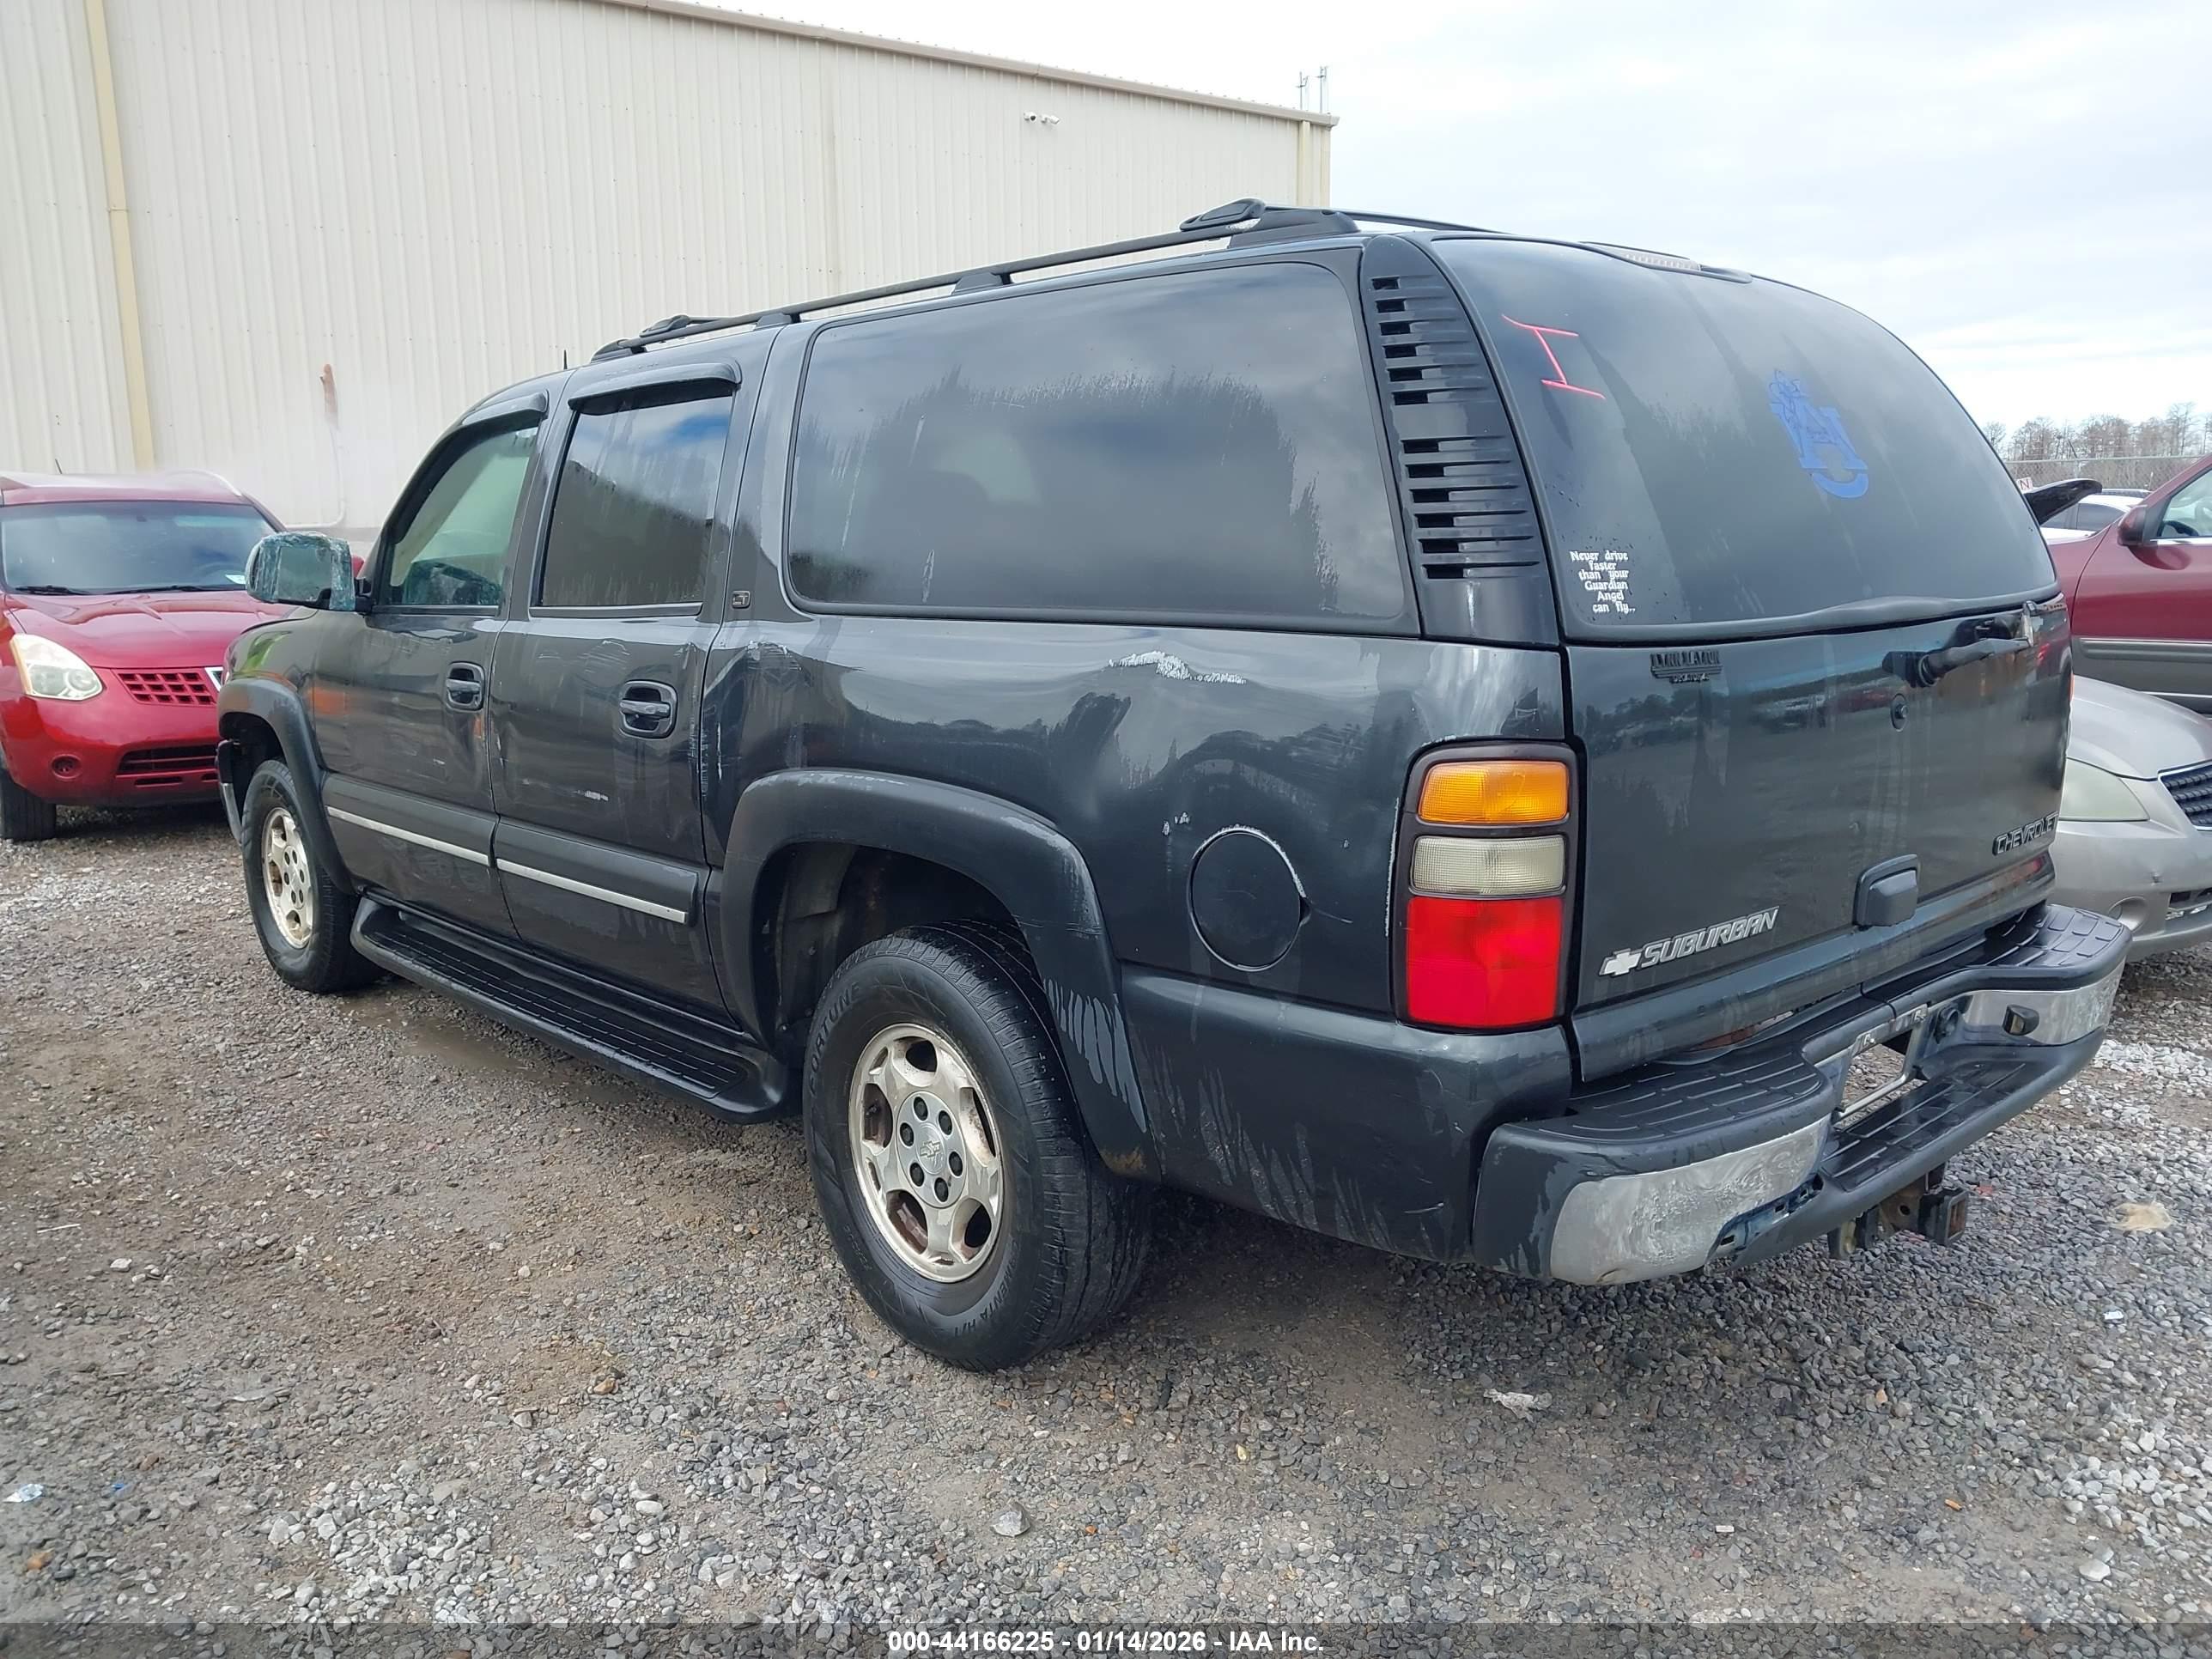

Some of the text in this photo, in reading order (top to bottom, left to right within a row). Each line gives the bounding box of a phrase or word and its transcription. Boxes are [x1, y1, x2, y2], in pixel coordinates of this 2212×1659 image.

[1570, 550, 1628, 562] Never drive
[1589, 560, 1616, 571] faster
[1578, 569, 1629, 580] than your
[1584, 580, 1628, 591] Guardian
[732, 595, 748, 605] LT
[1597, 590, 1625, 602] Angel
[1592, 603, 1610, 613] can
[1993, 811, 2058, 855] CHEVROLET
[1640, 906, 1780, 969] SUBURBAN
[810, 981, 860, 1097] FORTUNE
